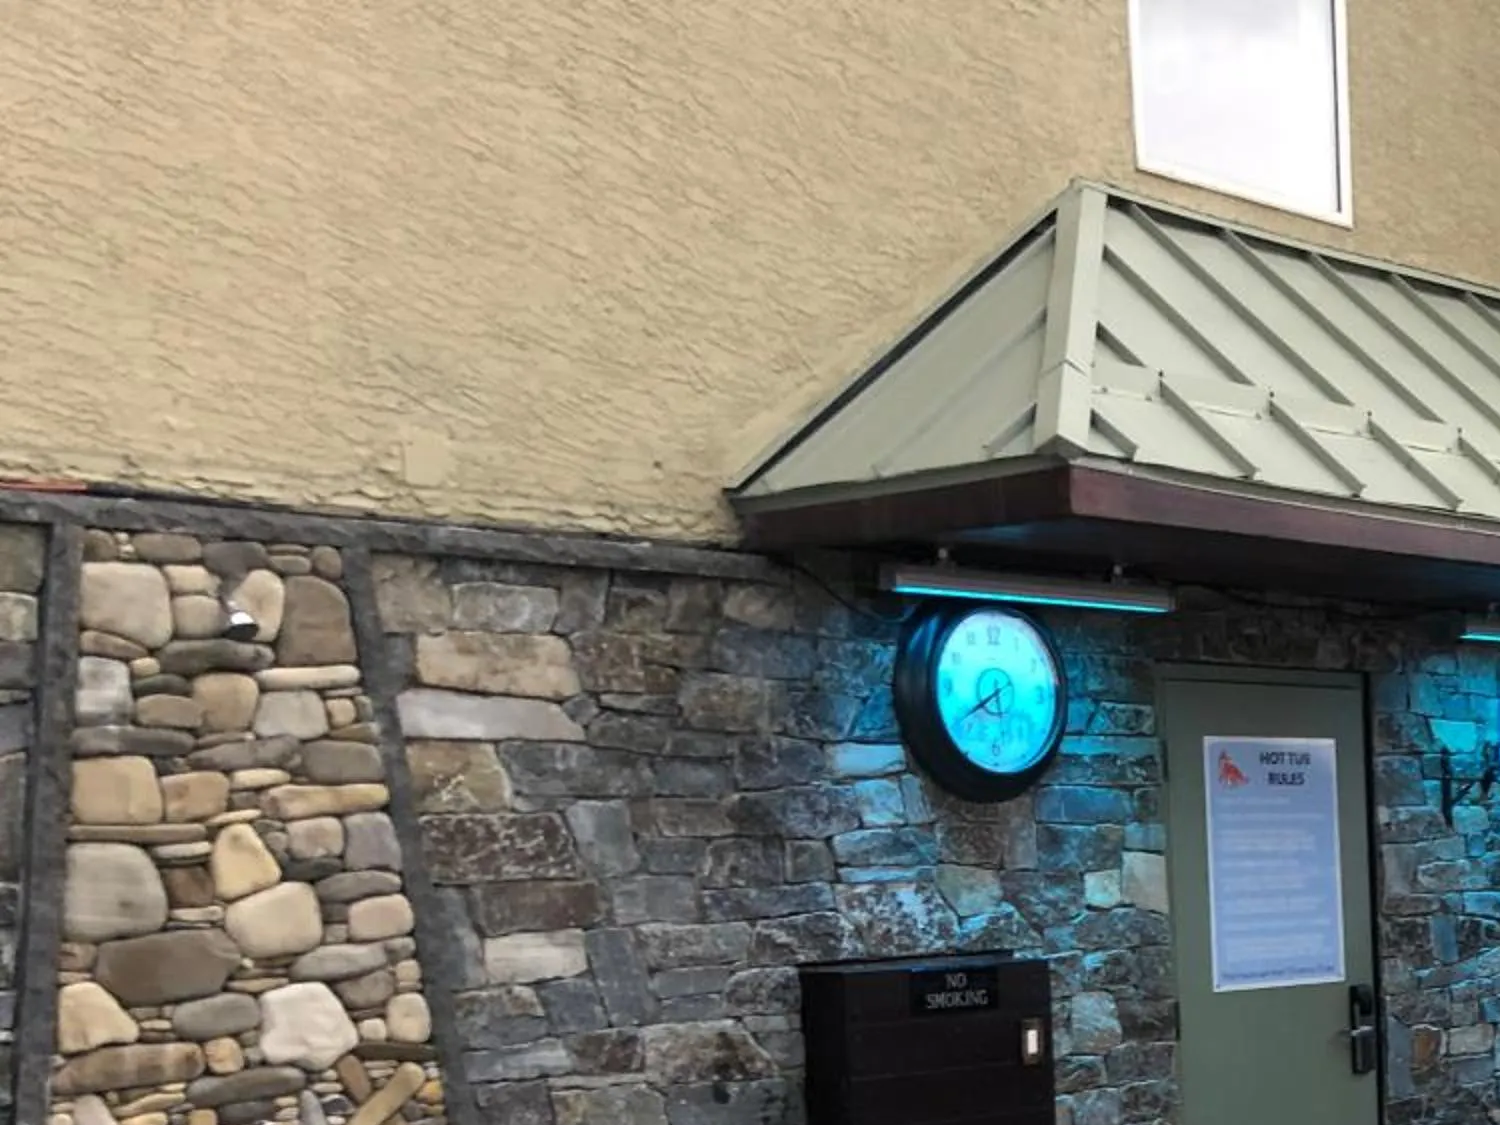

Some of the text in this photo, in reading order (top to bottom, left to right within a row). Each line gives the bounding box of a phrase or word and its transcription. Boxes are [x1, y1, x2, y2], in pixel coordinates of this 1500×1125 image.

[1259, 751, 1285, 765] HOT
[1267, 771, 1305, 786] RULES
[945, 972, 967, 989] NO
[925, 989, 988, 1009] SMOKING
